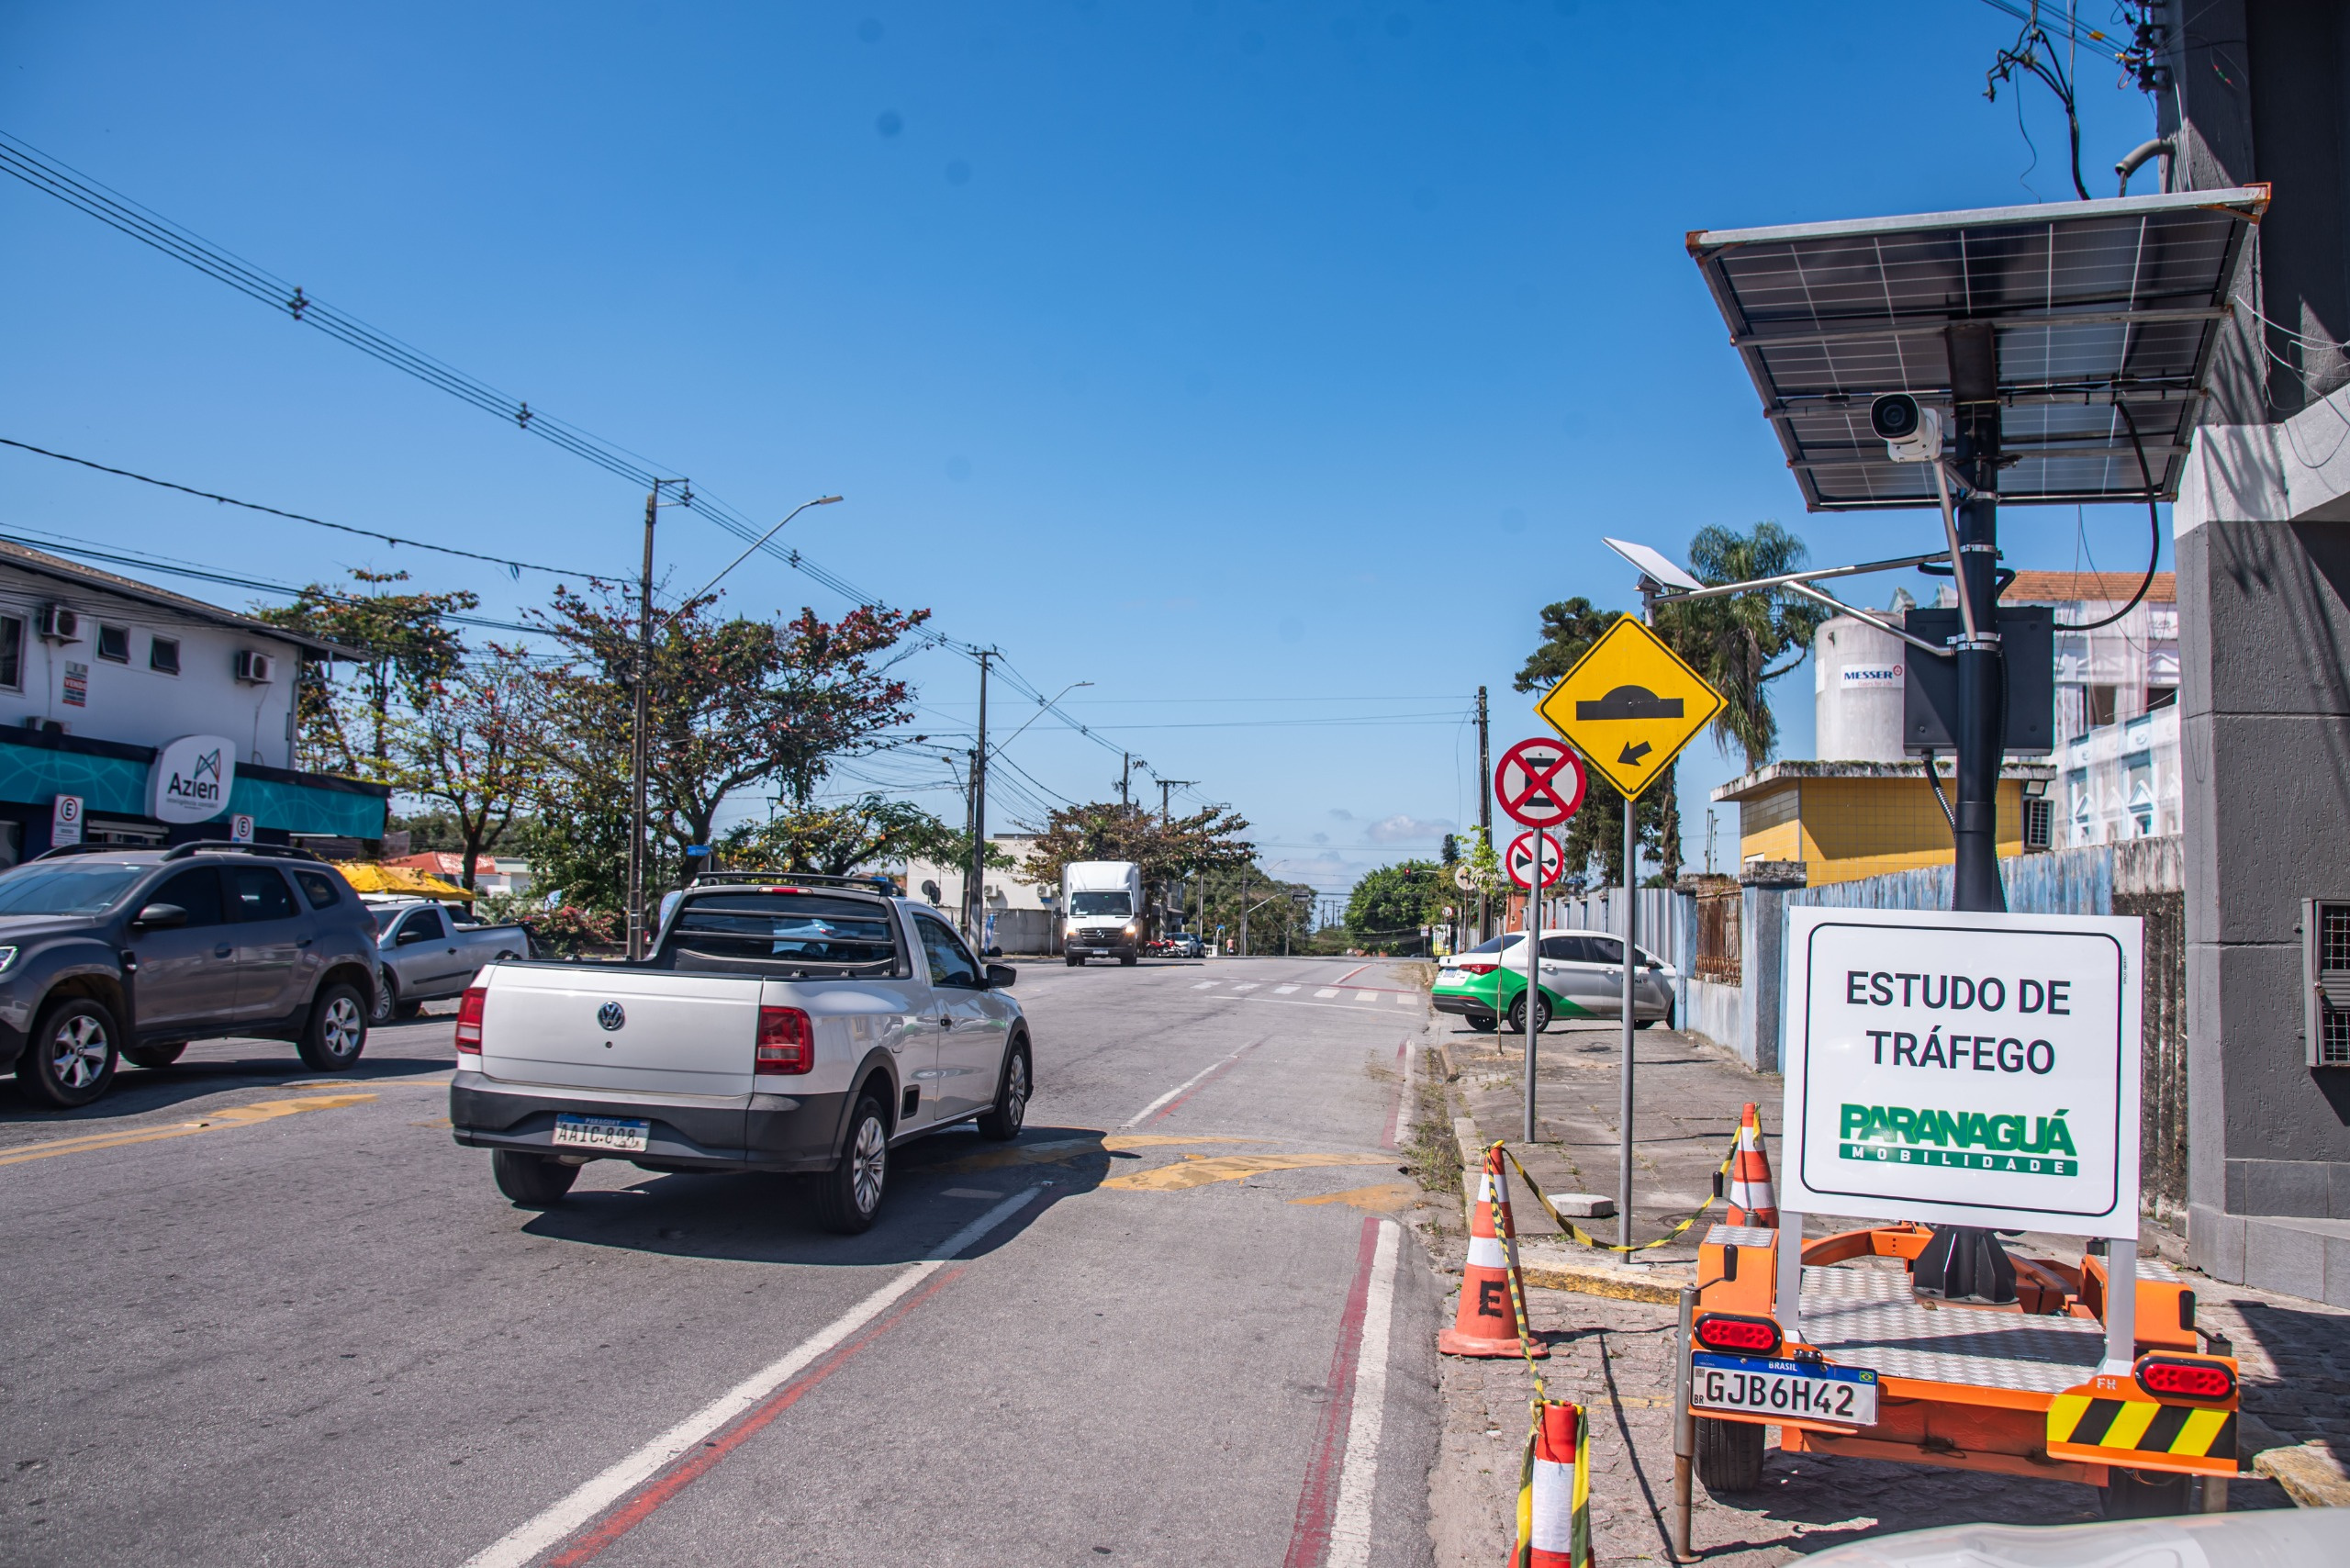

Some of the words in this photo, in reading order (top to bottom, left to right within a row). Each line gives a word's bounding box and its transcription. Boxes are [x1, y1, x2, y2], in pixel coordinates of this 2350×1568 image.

[1844, 670, 1893, 679] MESSER
[168, 772, 218, 801] Azien
[65, 802, 73, 816] E
[241, 821, 247, 833] E
[1847, 970, 2006, 1012] ESTUDO
[2019, 979, 2071, 1015] DE
[1865, 1025, 2055, 1074] TRÁFEGO
[585, 1117, 621, 1126] PARAGUAY
[1840, 1103, 2077, 1157] PARANAGUÁ
[1852, 1146, 2065, 1174] MOBILIDADE
[1479, 1280, 1505, 1318] E
[1768, 1361, 1798, 1372] BRASIL
[1694, 1394, 1705, 1405] BR
[1707, 1371, 1854, 1417] GJB6H42
